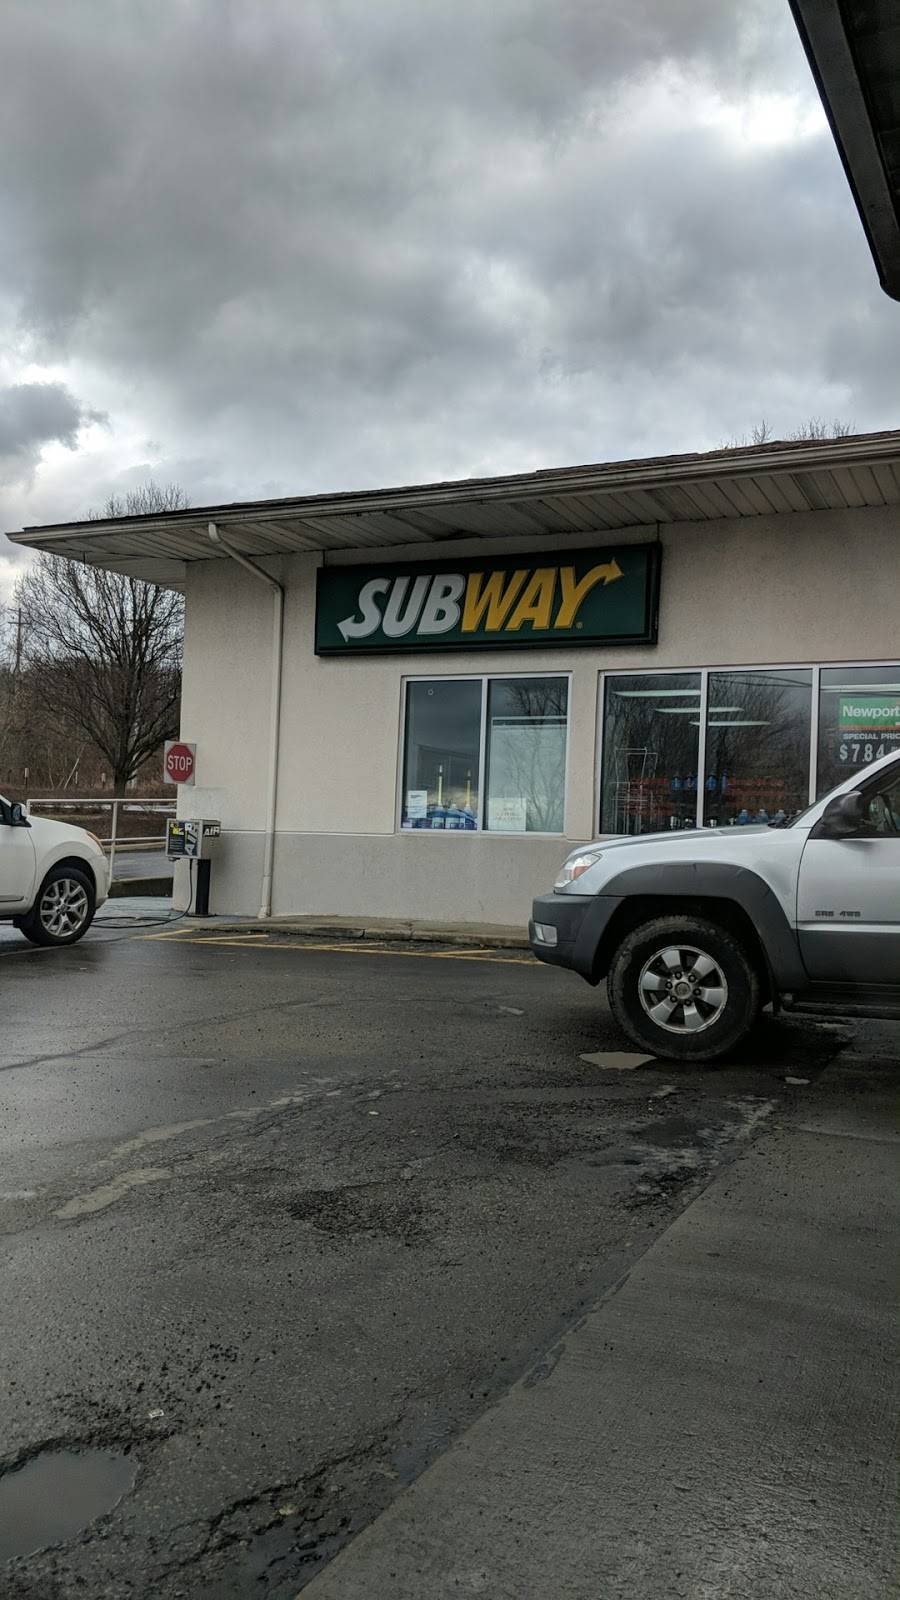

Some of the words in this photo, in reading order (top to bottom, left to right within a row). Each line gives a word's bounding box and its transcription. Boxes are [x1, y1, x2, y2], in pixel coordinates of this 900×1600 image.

[337, 558, 624, 642] SUBWAY
[842, 705, 900, 719] Newport
[167, 755, 193, 772] STOP
[204, 826, 220, 836] AIR
